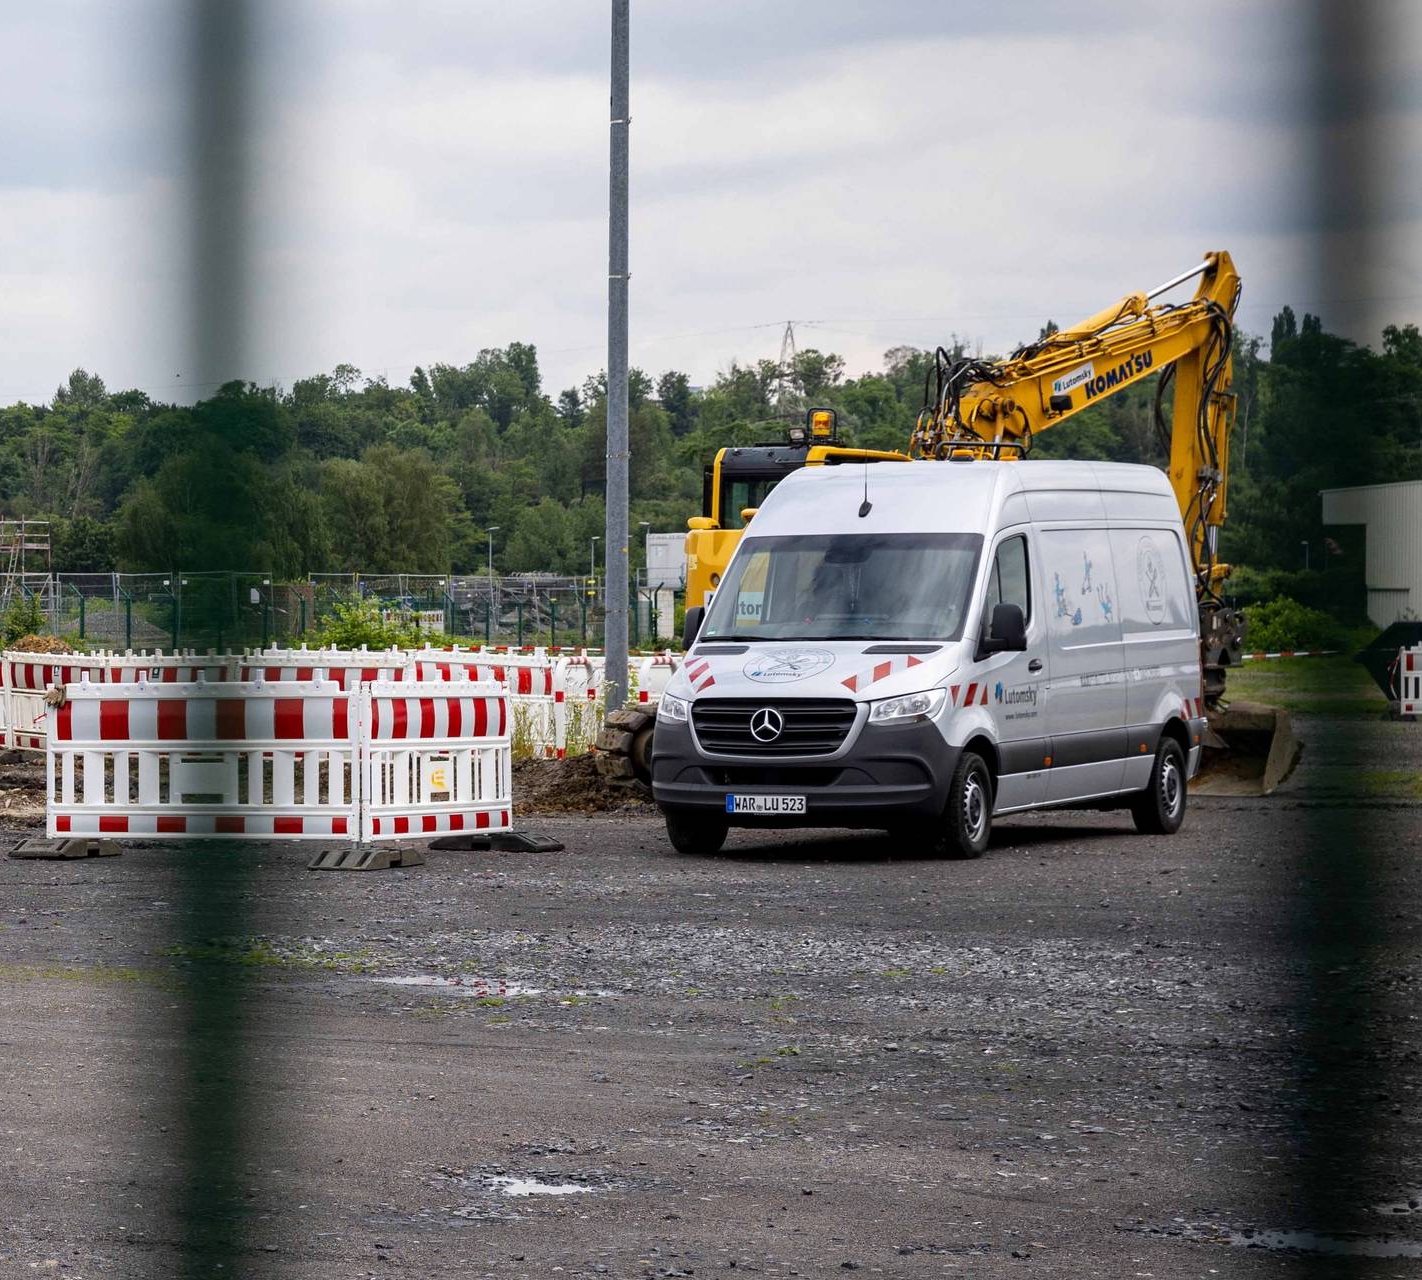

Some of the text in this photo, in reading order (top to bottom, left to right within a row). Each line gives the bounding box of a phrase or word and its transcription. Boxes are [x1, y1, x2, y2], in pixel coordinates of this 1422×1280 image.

[1063, 370, 1092, 389] Lutomsky
[1085, 350, 1153, 400] KOMATSU
[1005, 686, 1037, 706] Lutomsky
[735, 797, 804, 811] WAR LU 523
